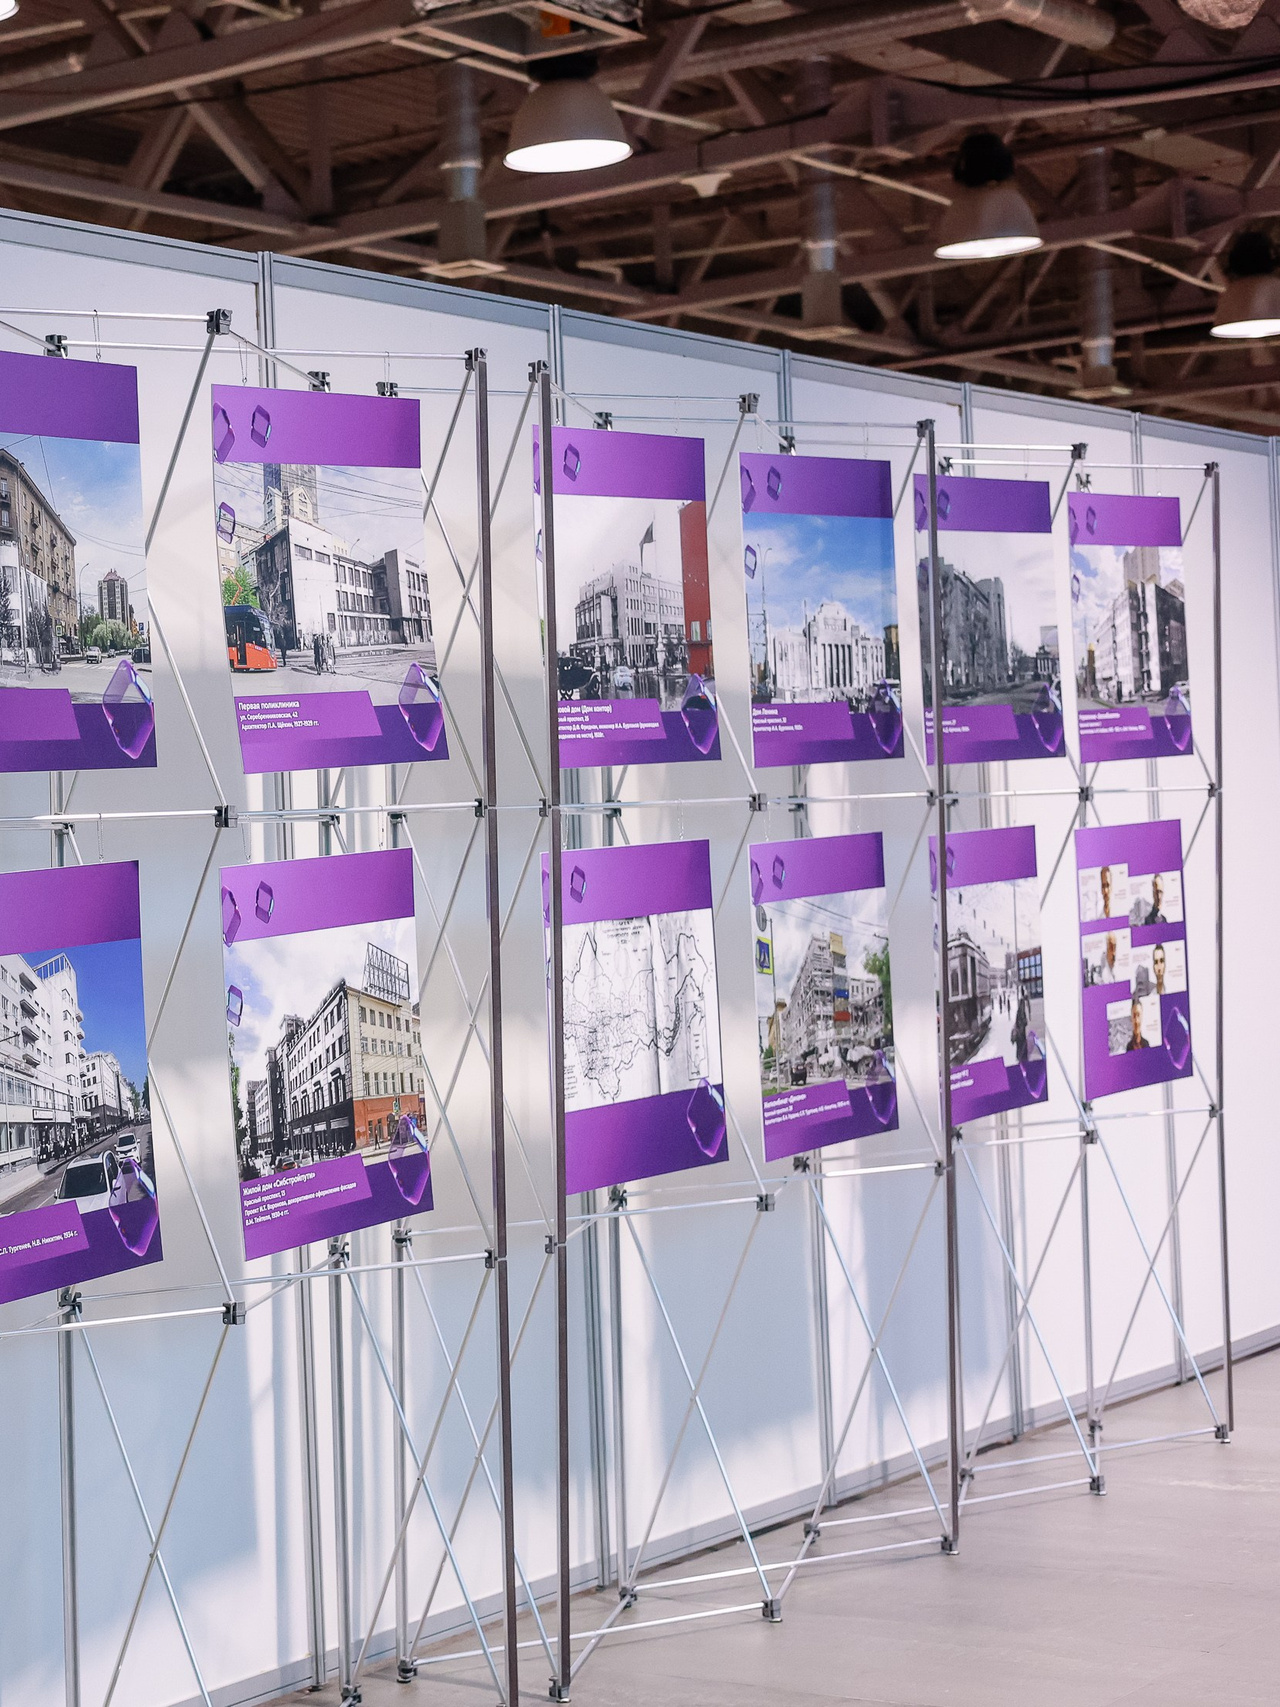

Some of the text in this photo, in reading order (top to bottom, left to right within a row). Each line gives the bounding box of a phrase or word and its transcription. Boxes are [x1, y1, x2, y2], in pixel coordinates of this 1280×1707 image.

[238, 701, 300, 711] Первая поликлиника
[243, 1173, 316, 1195] Жилой дом «Сибстройпути»
